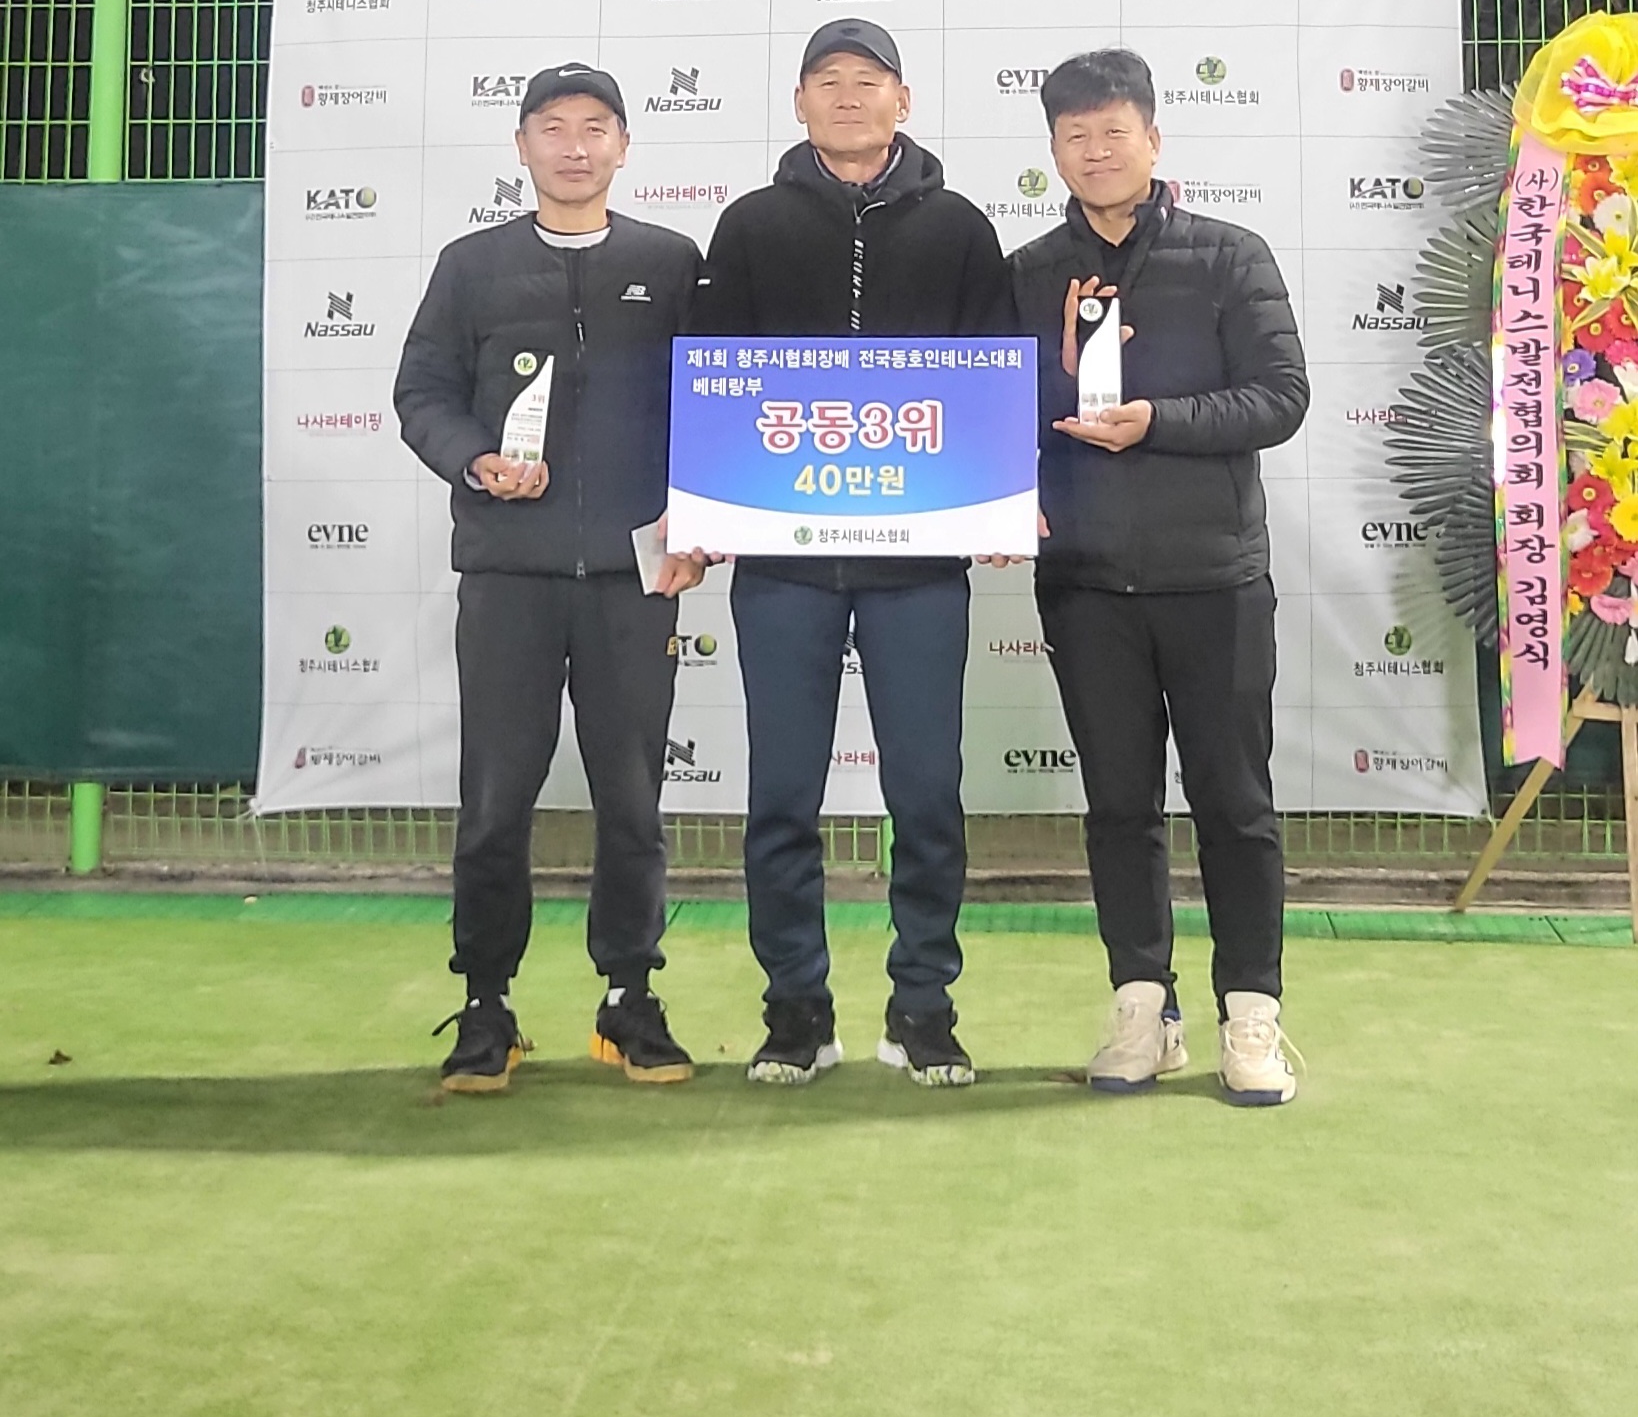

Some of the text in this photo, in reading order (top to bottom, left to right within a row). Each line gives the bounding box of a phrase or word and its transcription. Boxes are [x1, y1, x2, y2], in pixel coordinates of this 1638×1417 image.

[472, 76, 526, 96] KAT
[997, 69, 1049, 87] evn
[1357, 78, 1429, 93] 황제장어갈비
[318, 90, 387, 106] 황제장어갈비
[644, 96, 722, 112] Nassau
[1163, 90, 1259, 105] 청주시테니스협회
[634, 185, 728, 204] 나사라테이핑
[1184, 188, 1262, 203] 황제장어갈비
[1349, 177, 1424, 199] KATO
[306, 187, 377, 210] KATO
[468, 208, 523, 223] Nass
[985, 203, 1066, 218] 청주시테니스
[304, 321, 375, 338] Nassau
[1352, 313, 1428, 330] Nassau
[687, 349, 1022, 369] 제1회 청주시협회장배 전국동호인테니스대회
[692, 377, 763, 397] 베테랑부
[297, 413, 382, 431] 나사라테이핑
[757, 400, 943, 455] 공동3위
[1505, 167, 1558, 671] (사)한국테니스발전협의회 회장 김영식
[794, 465, 905, 496] 40만원
[307, 523, 369, 542] evne
[817, 528, 910, 544] 청주시테니스협회
[1361, 522, 1428, 541] evne
[677, 634, 717, 656] TO
[989, 640, 1047, 655] 나사라
[299, 659, 380, 673] 청주시테니스협회
[1354, 660, 1444, 677] 청주시테니스협회
[1004, 749, 1077, 767] evne
[663, 769, 721, 782] ssau
